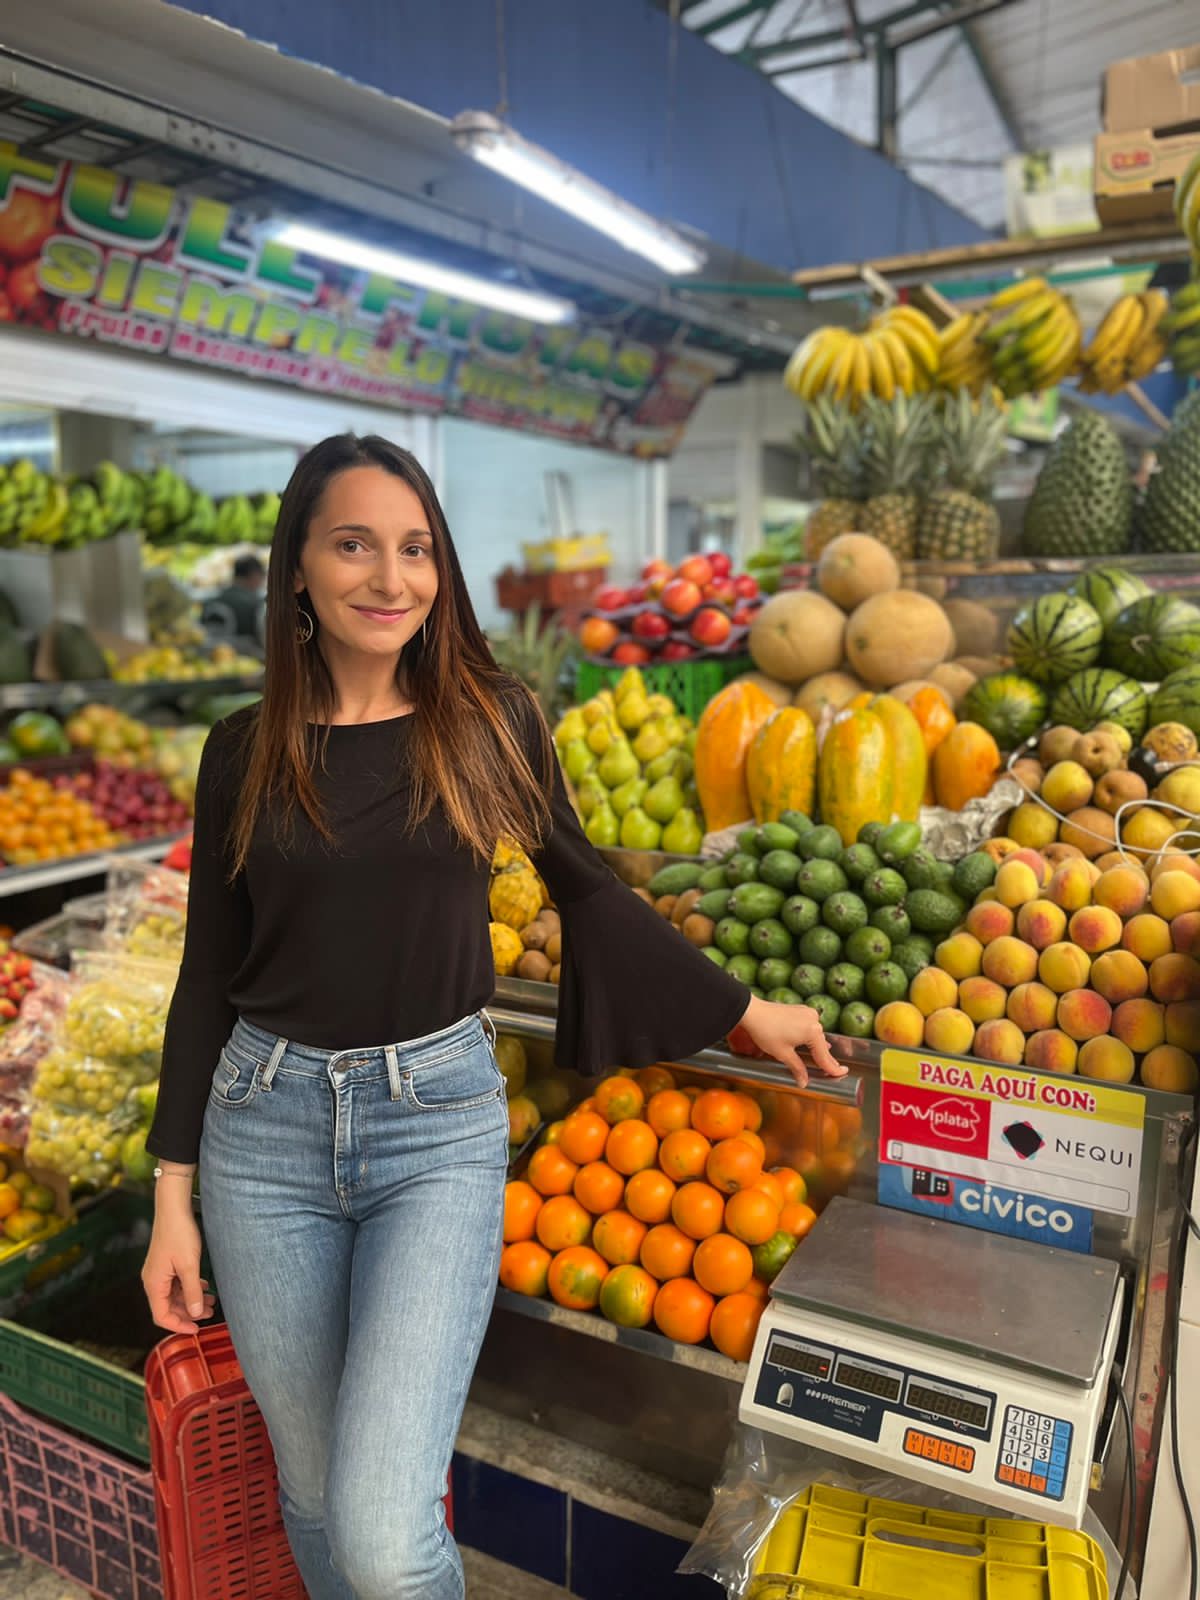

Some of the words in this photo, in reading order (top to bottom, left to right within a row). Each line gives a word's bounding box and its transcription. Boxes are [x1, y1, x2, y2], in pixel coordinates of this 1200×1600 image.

[38, 236, 374, 368] SIEMPRE
[919, 1062, 974, 1091] PAGA
[980, 1076, 1037, 1101] AQUÍ
[1041, 1085, 1096, 1113] CON:
[1055, 1138, 1133, 1168] NEQUI
[1013, 1410, 1020, 1421] 7
[1027, 1415, 1036, 1426] 8
[1043, 1419, 1051, 1431] 9
[1009, 1425, 1017, 1435] 4
[1025, 1429, 1032, 1440] 5
[1041, 1434, 1049, 1445] 6
[1005, 1454, 1013, 1465] 0
[1009, 1440, 1014, 1450] 1
[1022, 1444, 1031, 1455] 2
[1039, 1449, 1047, 1460] 3
